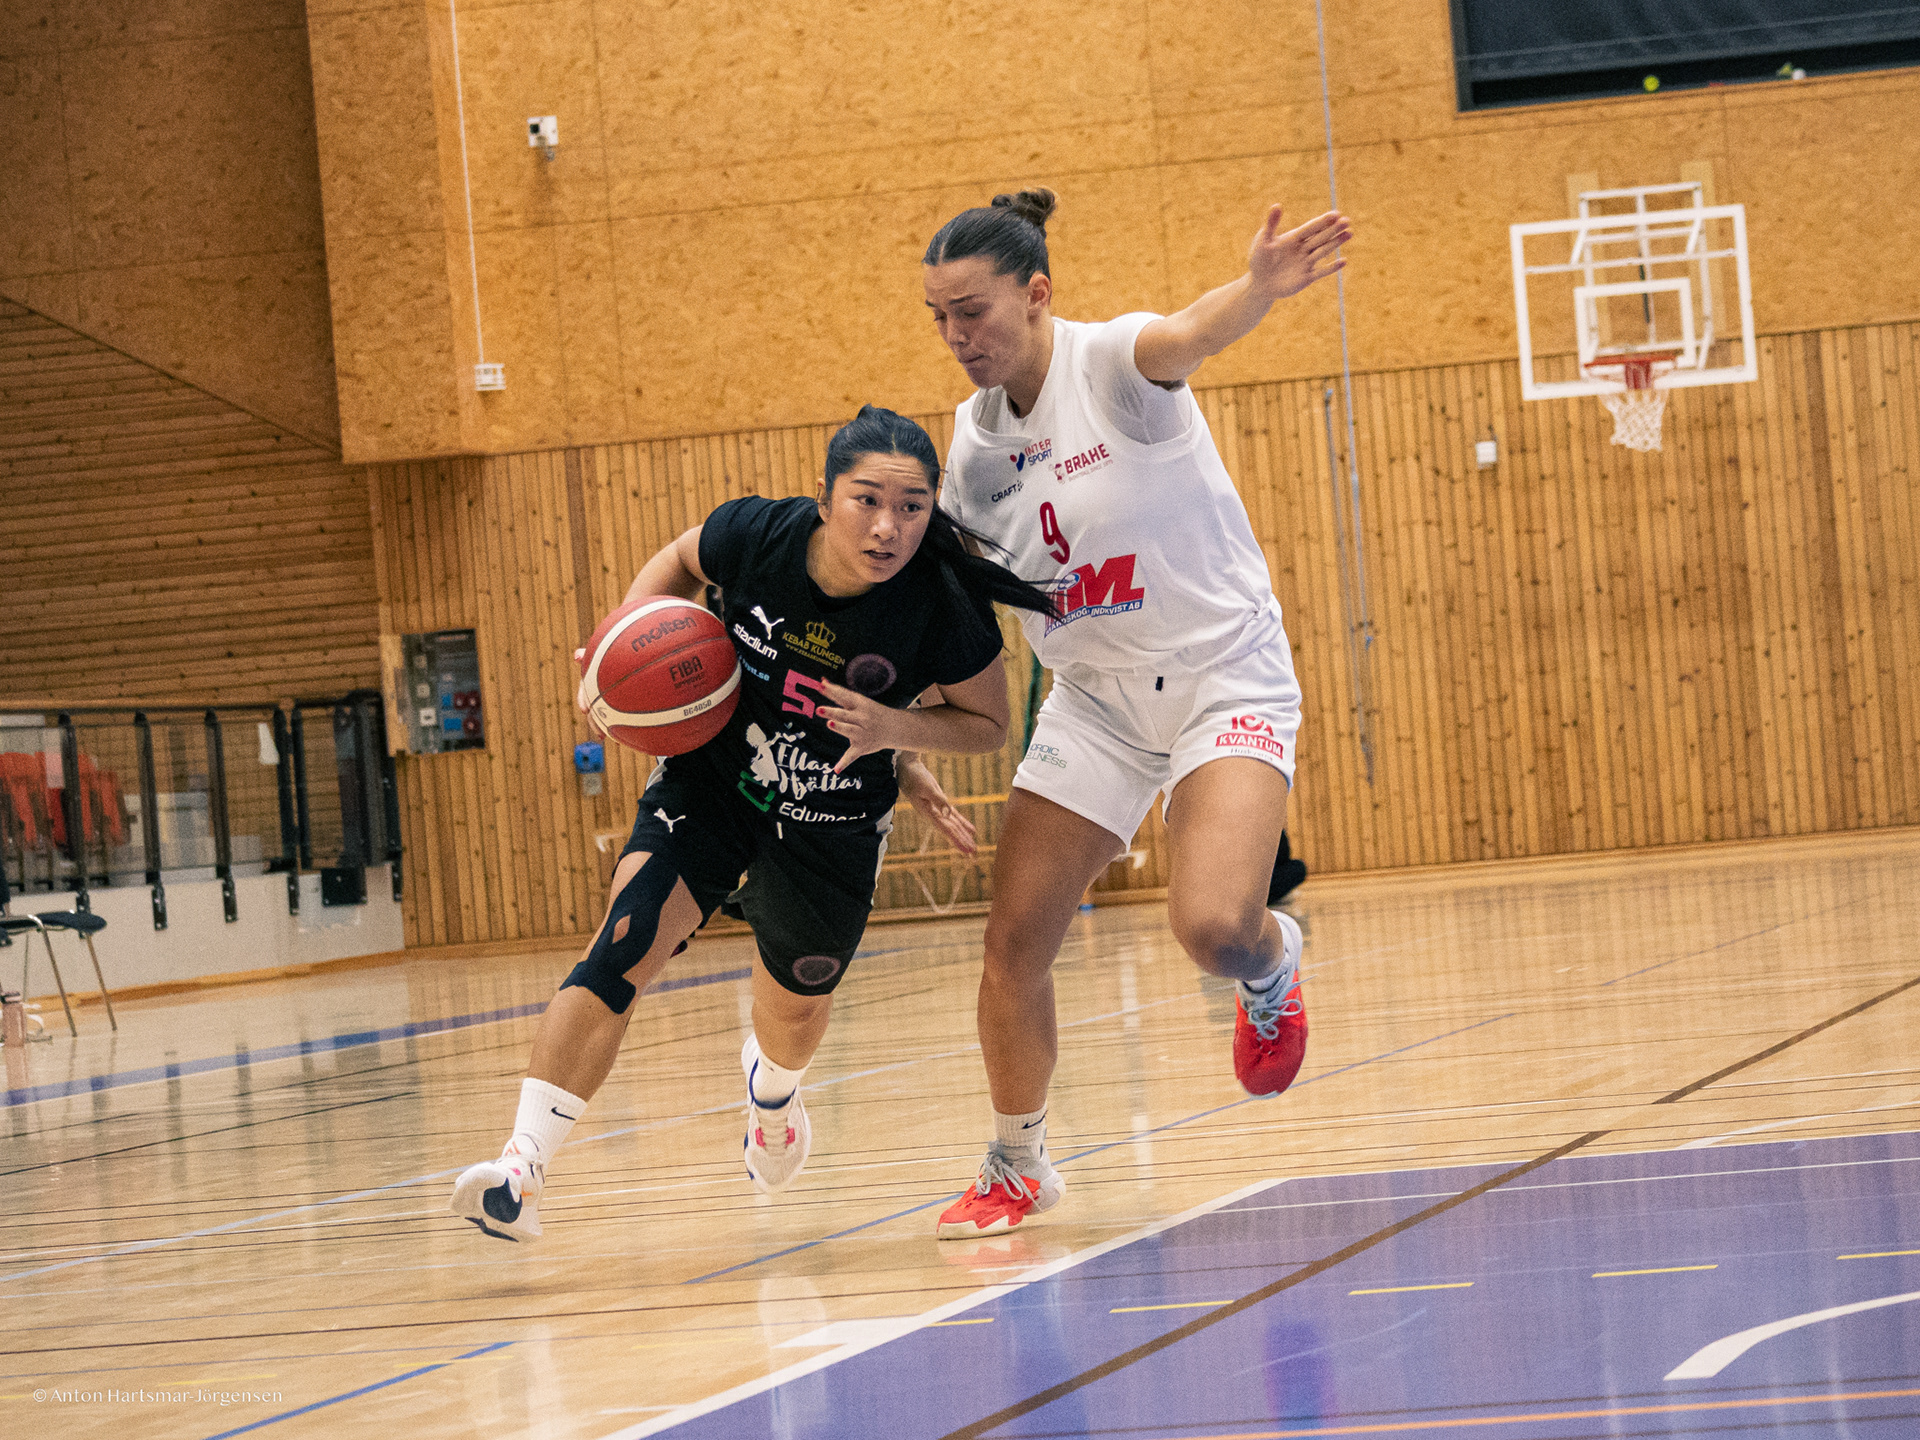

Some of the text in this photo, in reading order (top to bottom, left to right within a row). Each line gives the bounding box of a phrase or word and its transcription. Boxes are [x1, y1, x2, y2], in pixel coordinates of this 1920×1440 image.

[1024, 438, 1052, 457] INTER
[1027, 448, 1053, 467] SPORT
[1064, 443, 1110, 475] BRAHE
[991, 484, 1017, 503] CRAFT
[1039, 501, 1070, 565] 9
[631, 616, 698, 653] molten
[733, 623, 778, 660] stadium
[782, 631, 846, 666] KEBAB KUNGEN
[669, 655, 704, 682] FIBA
[782, 668, 824, 719] 5
[1231, 714, 1274, 737] ICA
[777, 742, 835, 774] Ellas
[1029, 743, 1060, 757] ORDIC
[1219, 734, 1281, 757] KVANTUM
[779, 767, 863, 800] Hjältar
